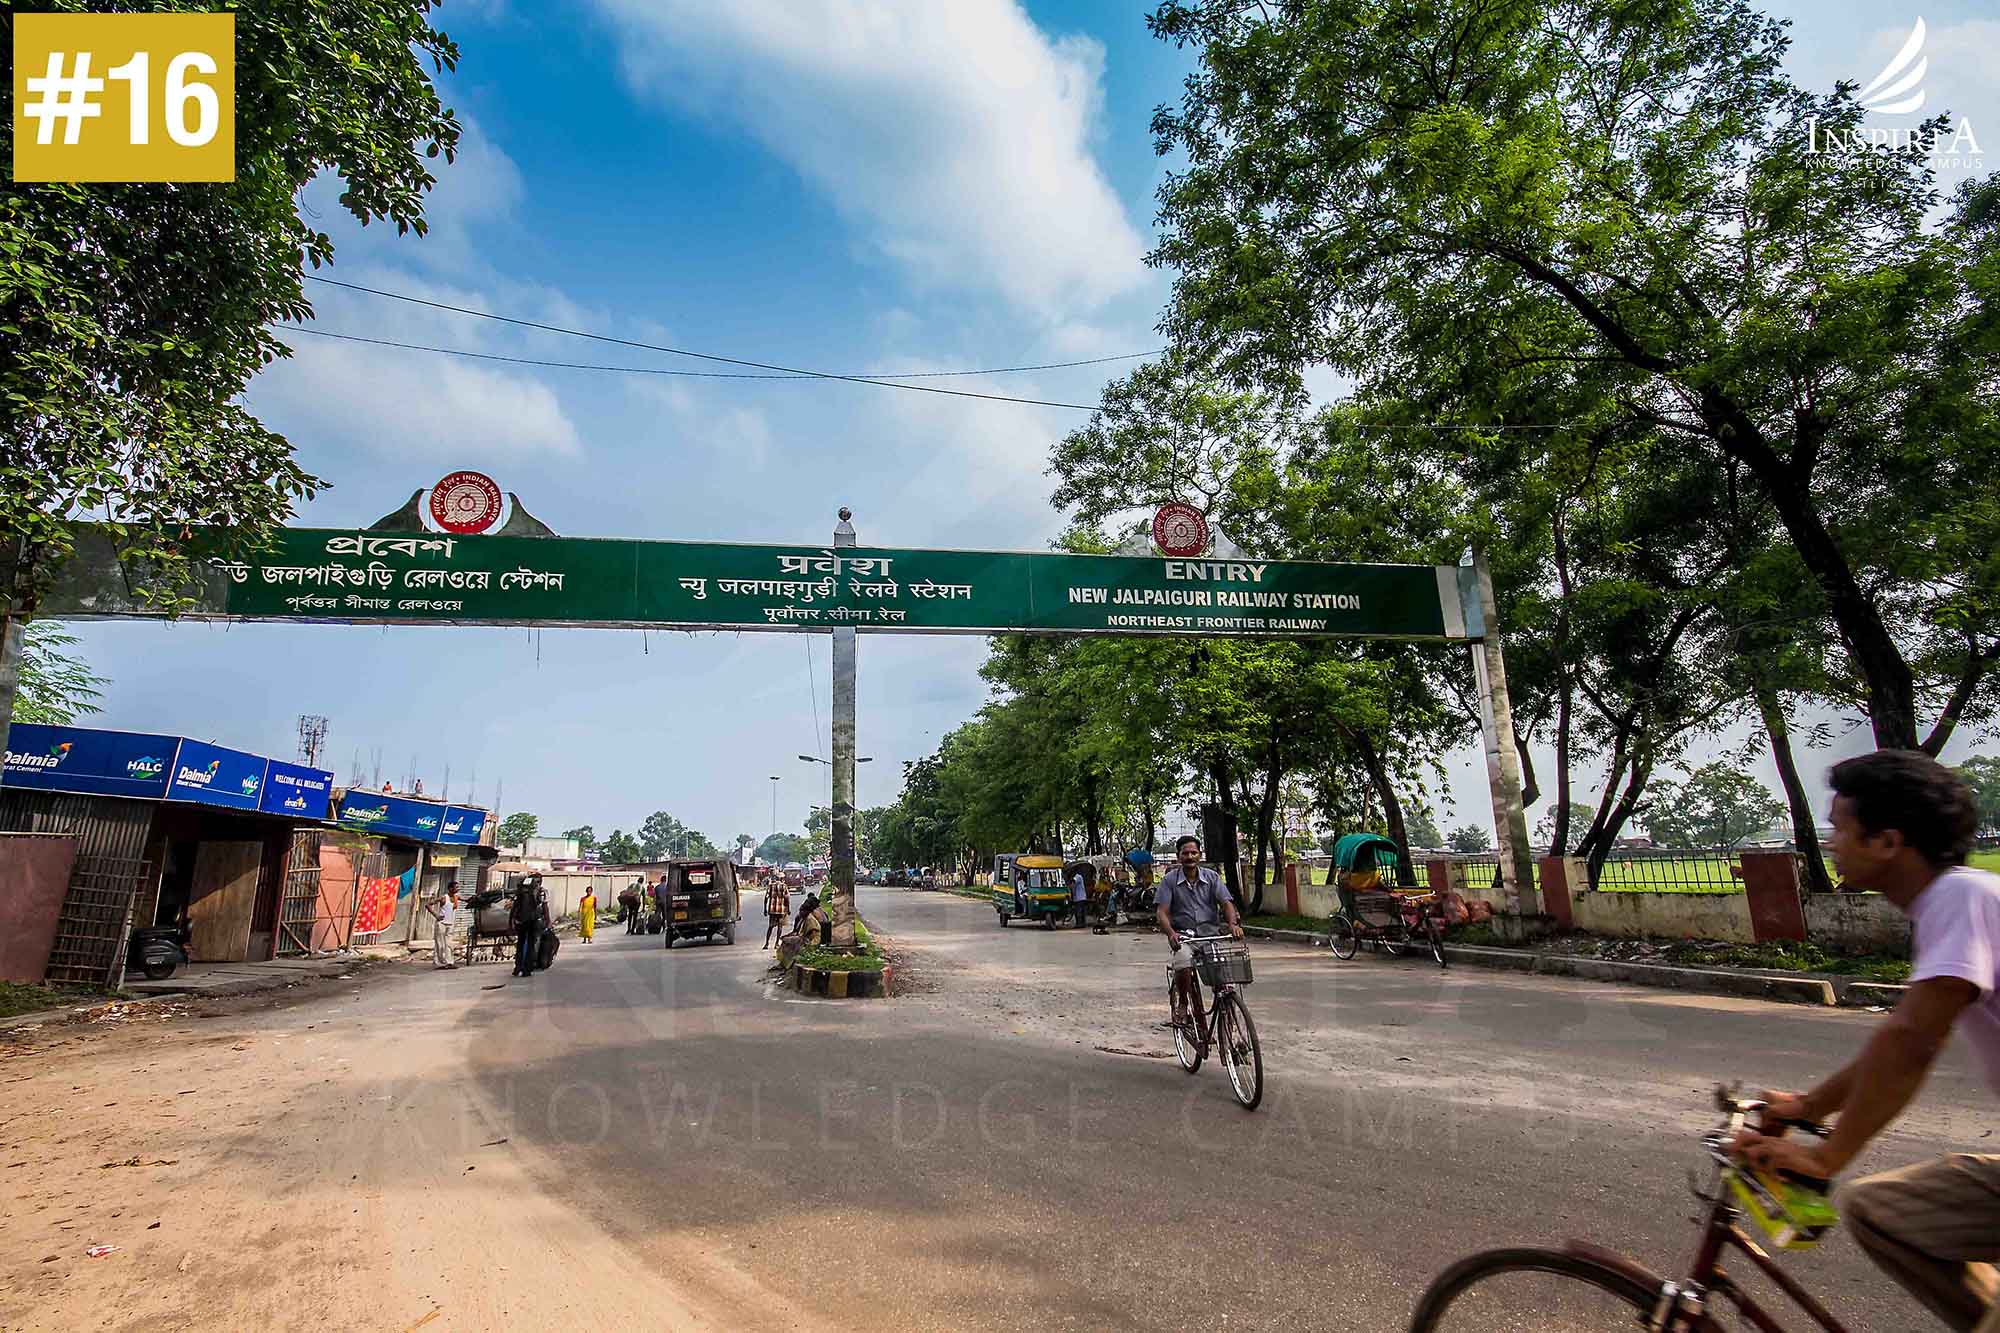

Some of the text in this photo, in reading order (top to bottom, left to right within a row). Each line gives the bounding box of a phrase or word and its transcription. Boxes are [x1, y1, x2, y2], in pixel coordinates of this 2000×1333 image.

[462, 474, 500, 522] INDIAN RAILWAYS
[325, 534, 459, 559] প্রবেশ
[777, 549, 893, 576] प्रवेश
[1165, 561, 1268, 582] ENTRY
[261, 560, 397, 590] জলপাইগুড়ি
[404, 569, 492, 590] রেলওয়ে
[500, 565, 566, 592] স্টেশন
[678, 576, 973, 603] न्यु जलपाइगुड़ी रेलवे स्टेशन
[1068, 587, 1361, 610] NEW JALPAIGURI RAILWAY STATION
[344, 594, 392, 610] সীমান্ত
[398, 599, 463, 611] রেলওয়ে
[763, 605, 821, 622] पूर्वोत्तर
[1107, 615, 1328, 630] NORTHEAST FRONTIER RAILWAY
[16, 765, 42, 773] Cement
[127, 760, 163, 773] HALC
[178, 766, 212, 784] Dalmia
[416, 817, 437, 827] HALC
